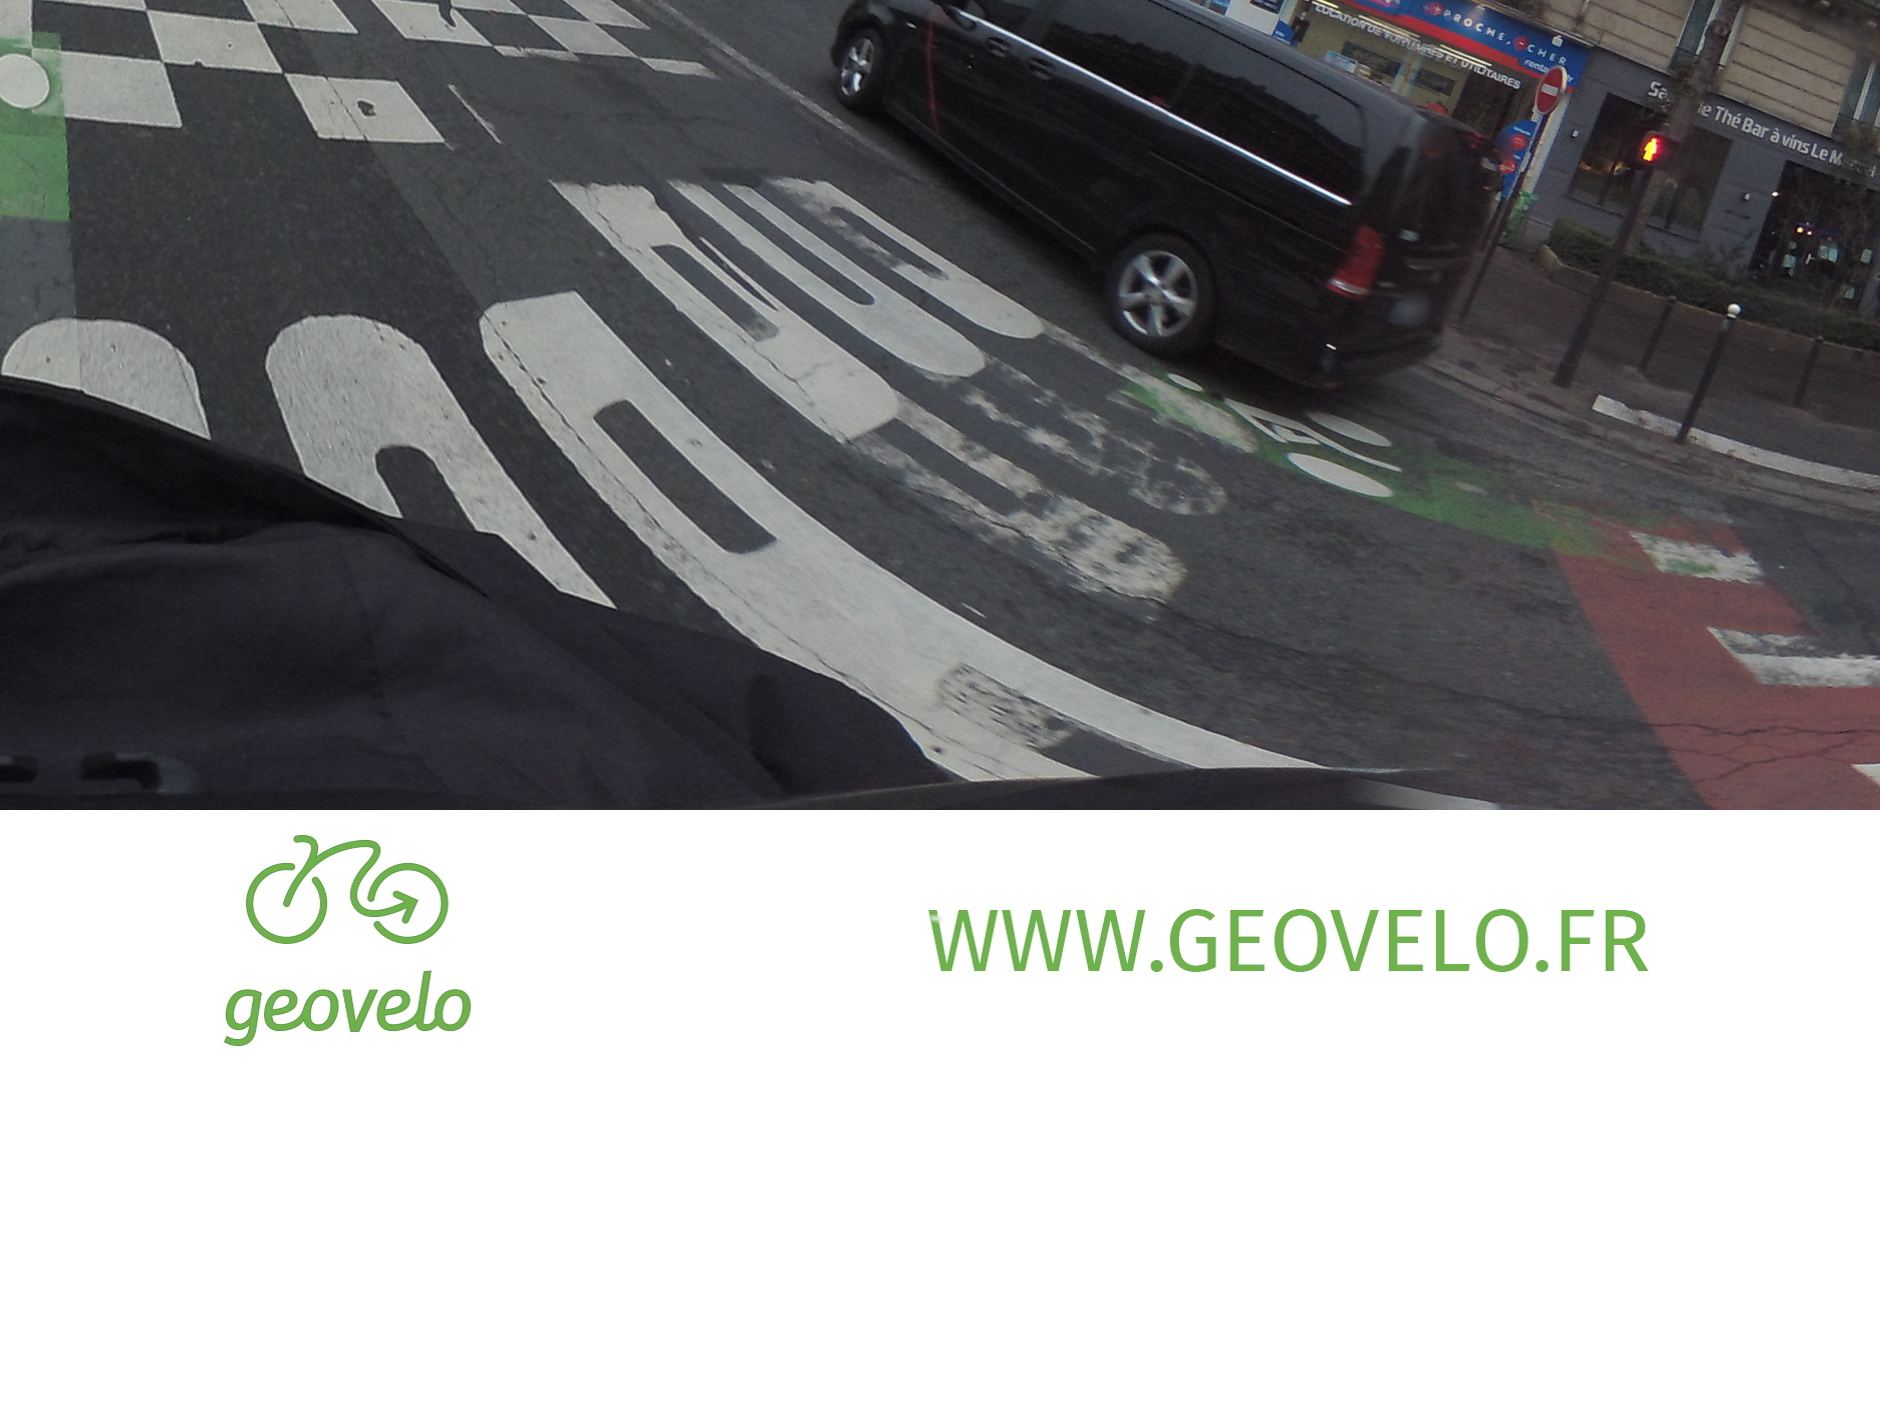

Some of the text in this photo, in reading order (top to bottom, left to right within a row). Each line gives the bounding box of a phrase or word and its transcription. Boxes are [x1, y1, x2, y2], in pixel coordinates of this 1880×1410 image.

[1460, 57, 1522, 90] UTILITAIRES
[1714, 104, 1742, 130] Thé
[1741, 117, 1769, 139] Bar
[1769, 127, 1780, 144] à
[1781, 133, 1810, 155] vins
[1810, 142, 1829, 162] Le
